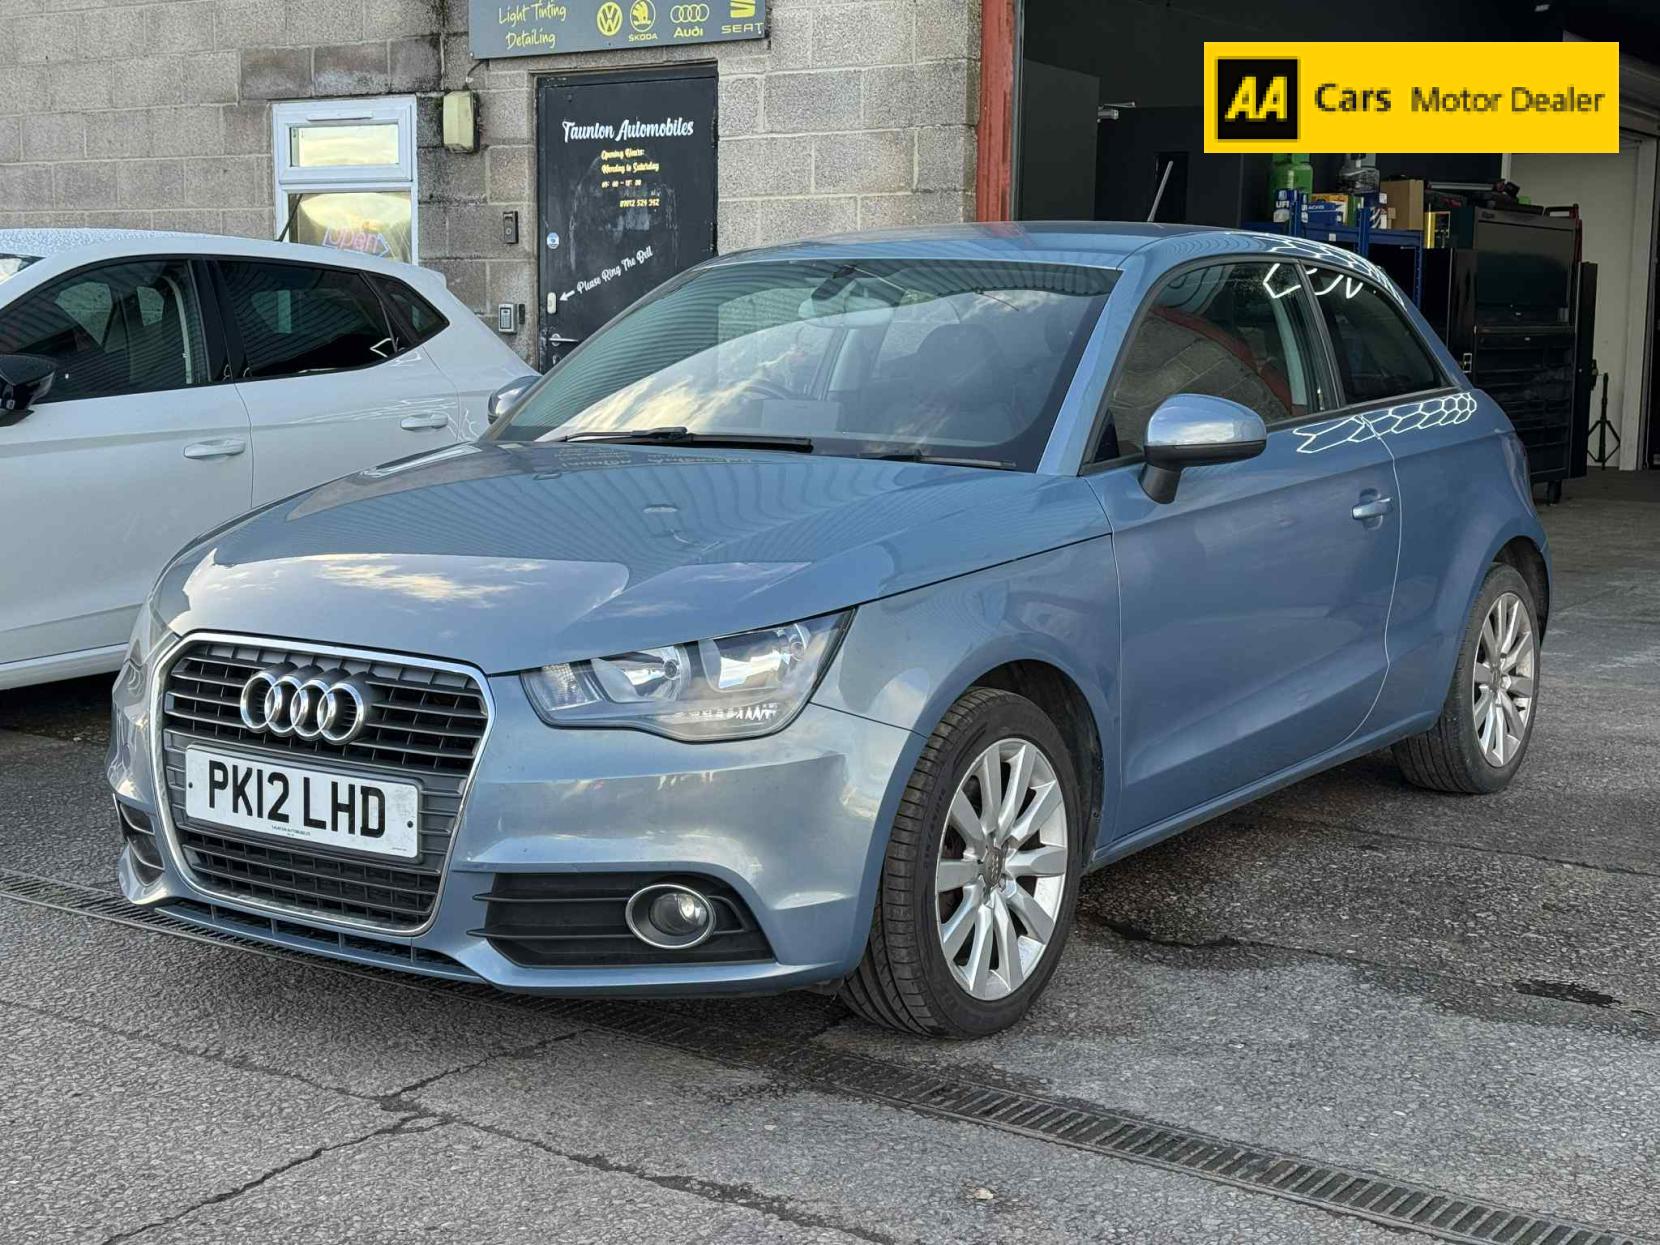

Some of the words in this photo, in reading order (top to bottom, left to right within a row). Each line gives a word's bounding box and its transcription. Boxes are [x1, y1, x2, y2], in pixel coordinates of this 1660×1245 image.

[498, 4, 530, 28] Light
[530, 0, 566, 22] Tinting
[505, 28, 556, 50] Detailing
[673, 25, 704, 39] Audi
[721, 22, 764, 34] SEAT
[562, 120, 615, 143] Taunton
[615, 117, 694, 142] Automobiles
[601, 164, 625, 175] Monday
[632, 162, 660, 173] Saturday
[577, 279, 602, 294] Please
[602, 265, 622, 283] Ring
[621, 257, 636, 271] The
[636, 245, 654, 264] Bell
[208, 759, 290, 824] PK12
[303, 776, 386, 839] LHD
